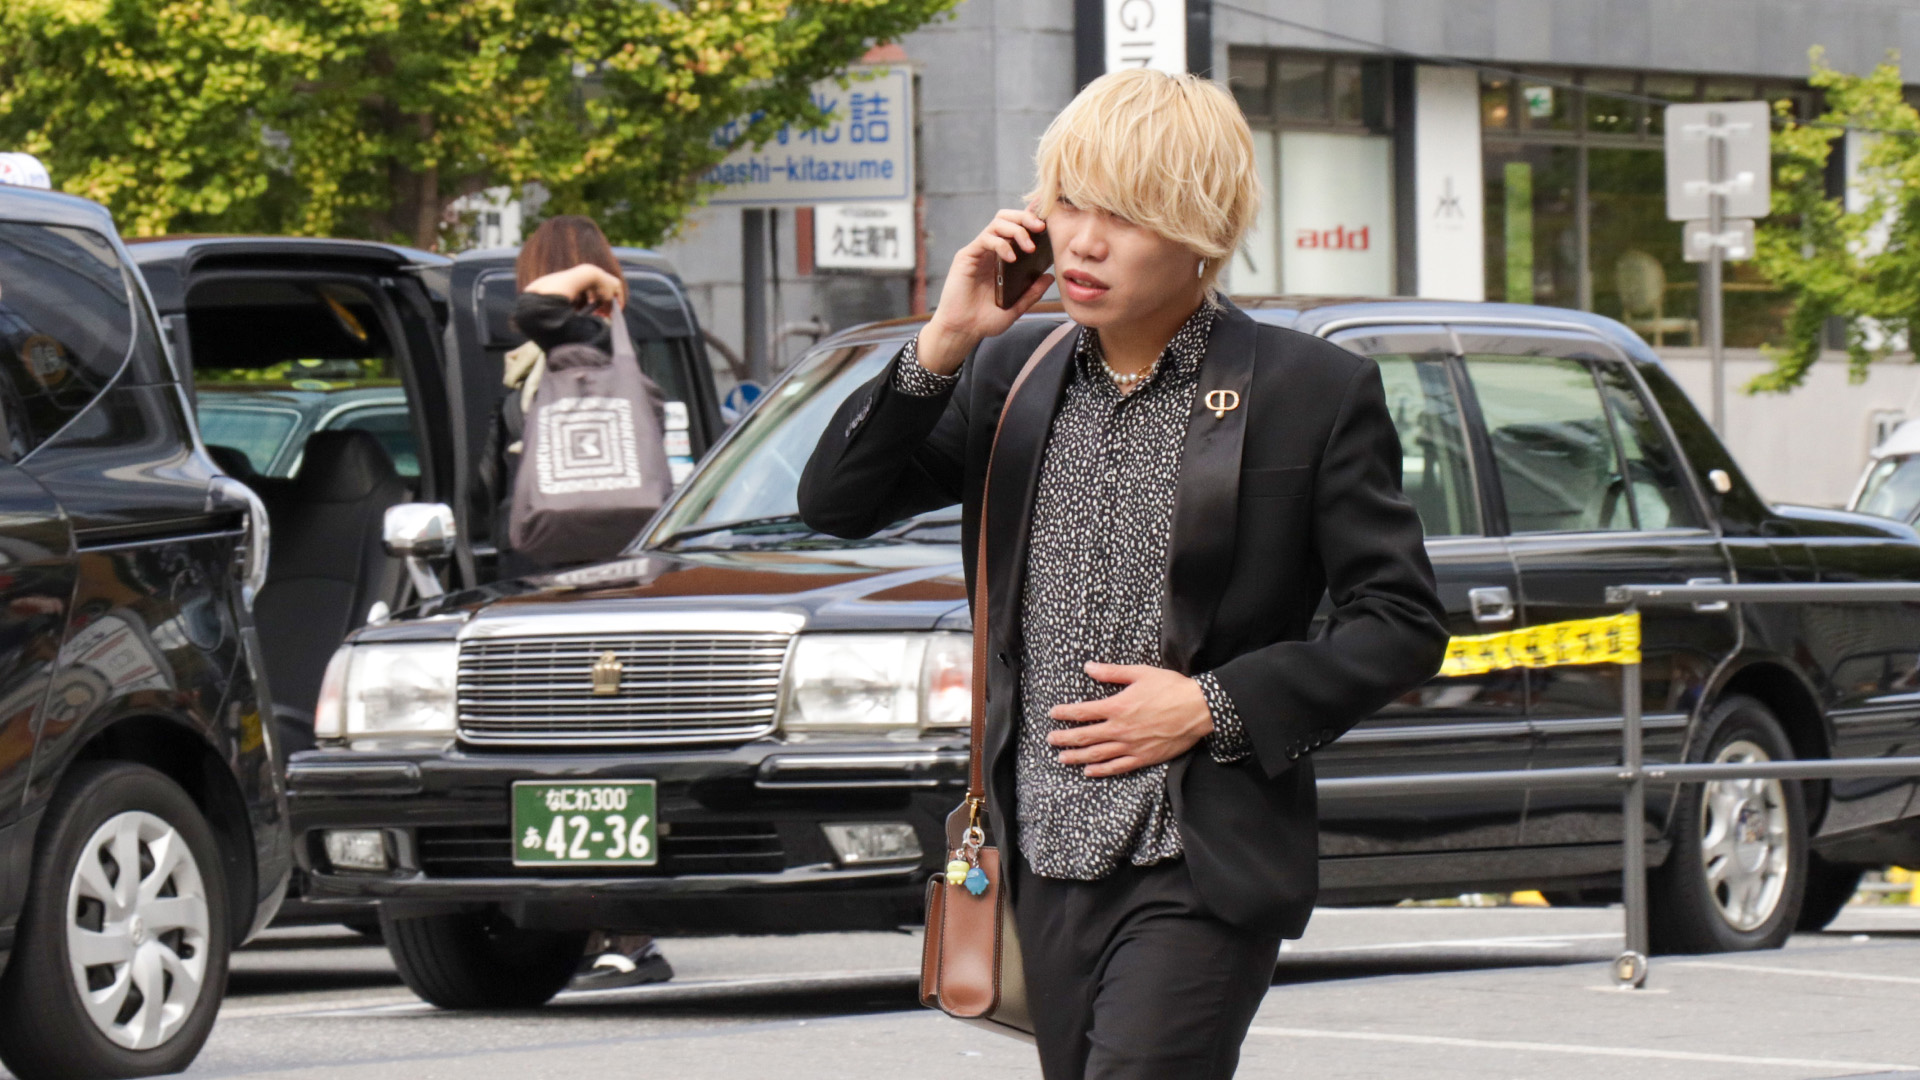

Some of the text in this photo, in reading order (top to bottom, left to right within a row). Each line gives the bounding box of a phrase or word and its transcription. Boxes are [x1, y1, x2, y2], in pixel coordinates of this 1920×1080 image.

[703, 155, 894, 185] bashi-kitazume
[1296, 225, 1370, 251] add
[545, 787, 628, 812] なにわ300
[522, 814, 650, 859] あ 42-36
